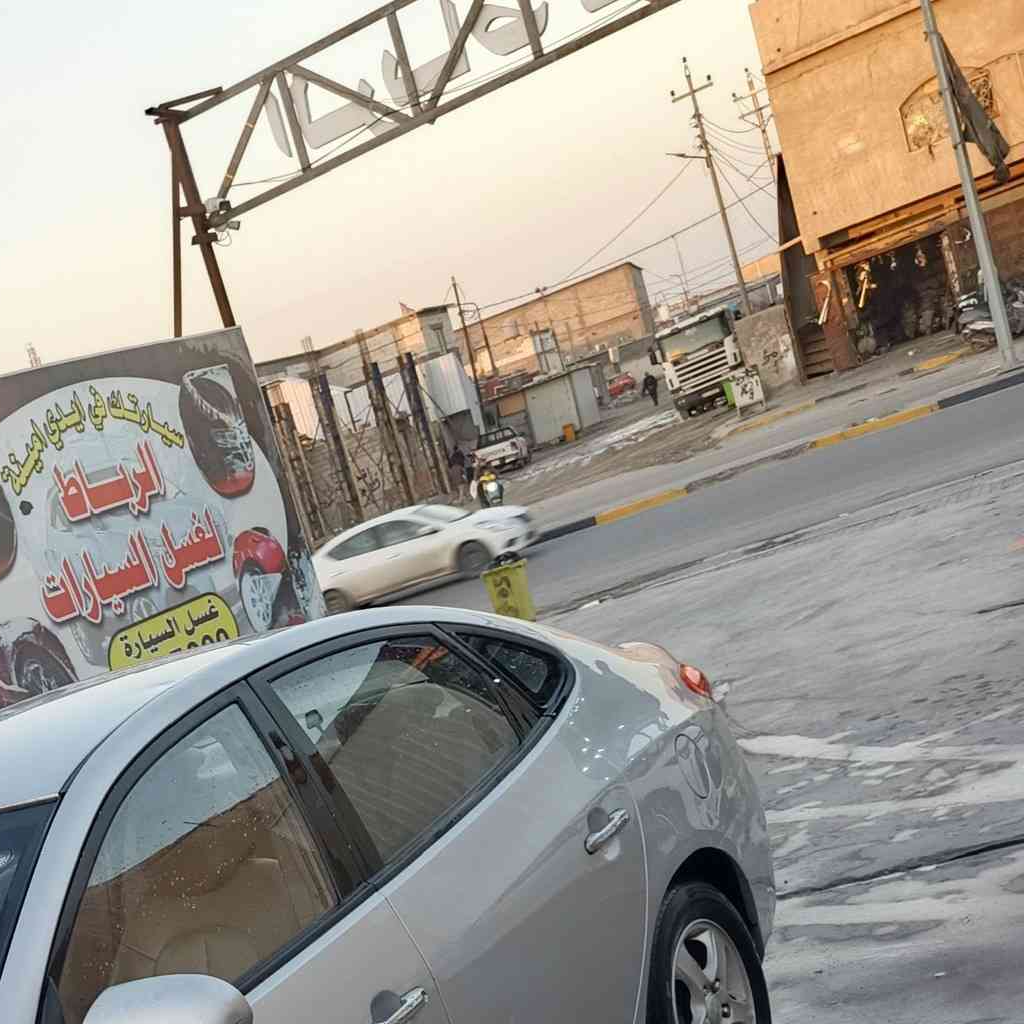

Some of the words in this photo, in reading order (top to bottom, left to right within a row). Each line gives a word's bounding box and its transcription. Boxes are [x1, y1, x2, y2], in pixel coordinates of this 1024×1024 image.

[88, 385, 108, 431] في
[108, 390, 184, 449] سيارتك
[53, 440, 165, 521] الرباط
[41, 528, 158, 623] السيارات
[160, 504, 225, 588] لغسل
[120, 617, 180, 659] السيارة
[184, 599, 219, 636] غسل
